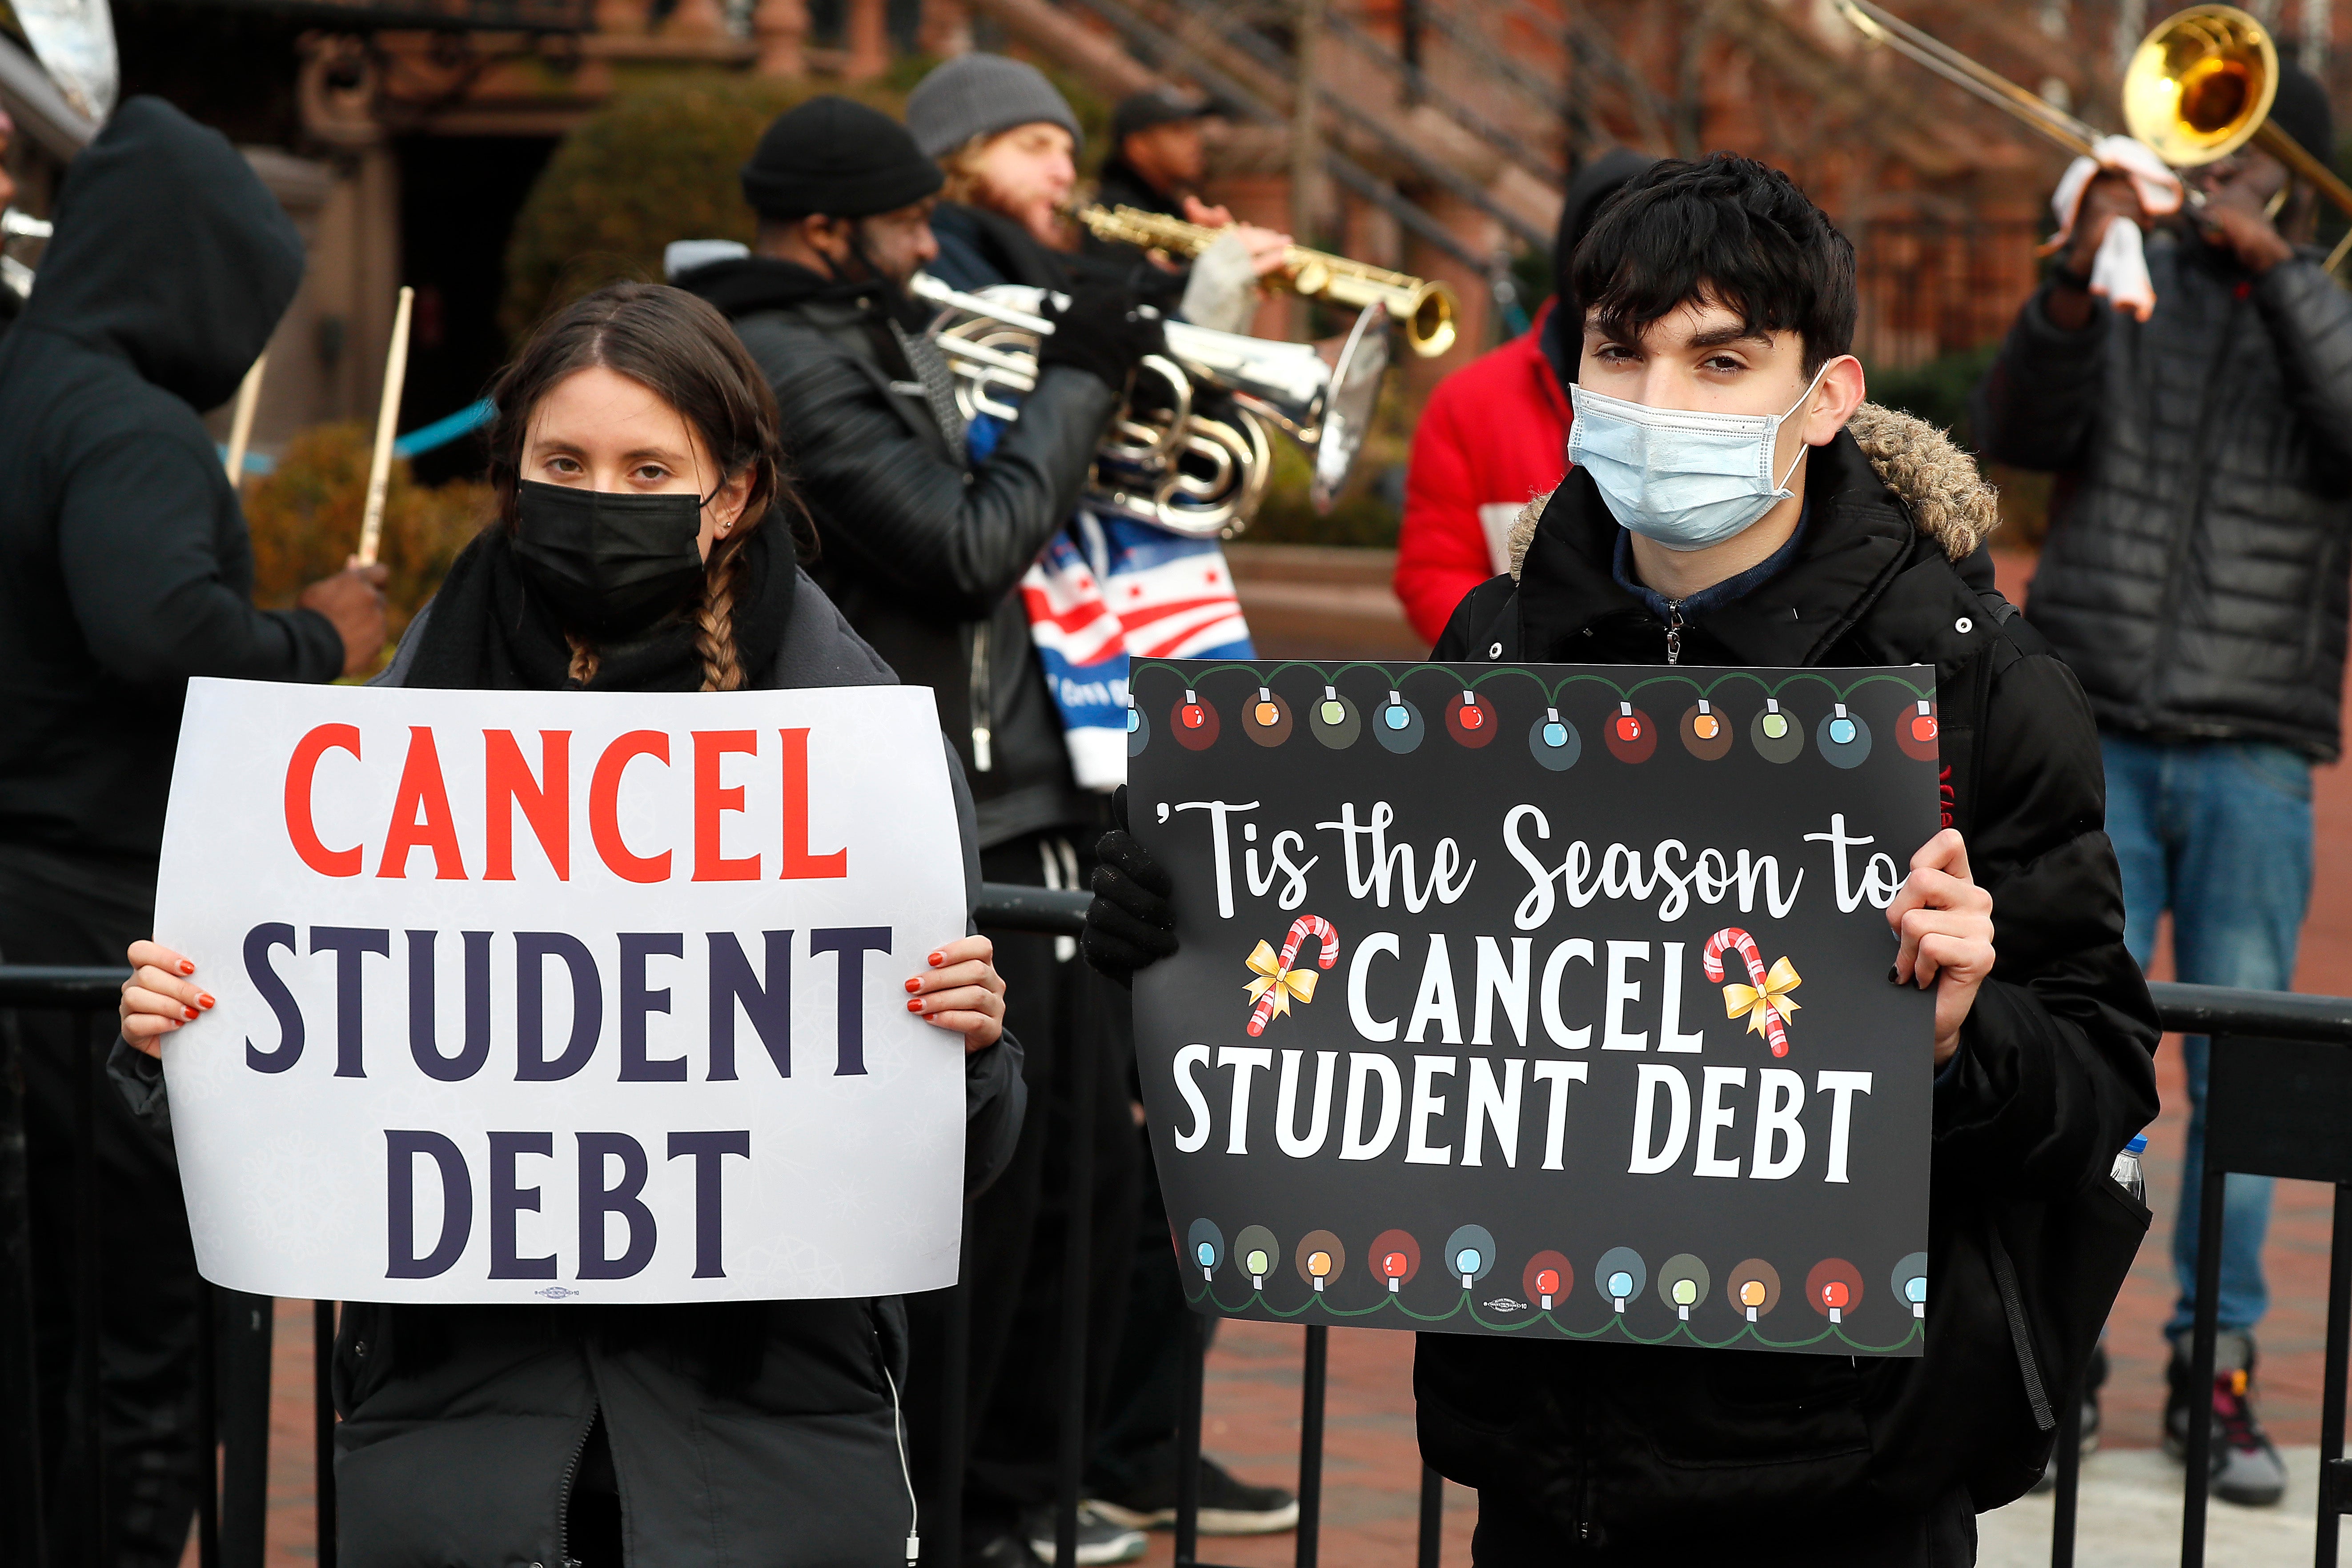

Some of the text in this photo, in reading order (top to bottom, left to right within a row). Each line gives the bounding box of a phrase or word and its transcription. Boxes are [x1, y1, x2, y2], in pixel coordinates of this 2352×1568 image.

[285, 723, 847, 883] CANCEL
[1156, 800, 1911, 931] 'Tis the Season to
[243, 922, 892, 1082] STUDENT
[1348, 932, 1703, 1053] CANCEL
[1173, 1044, 1873, 1183] STUDENT DEBT
[383, 1129, 750, 1280] DEBT
